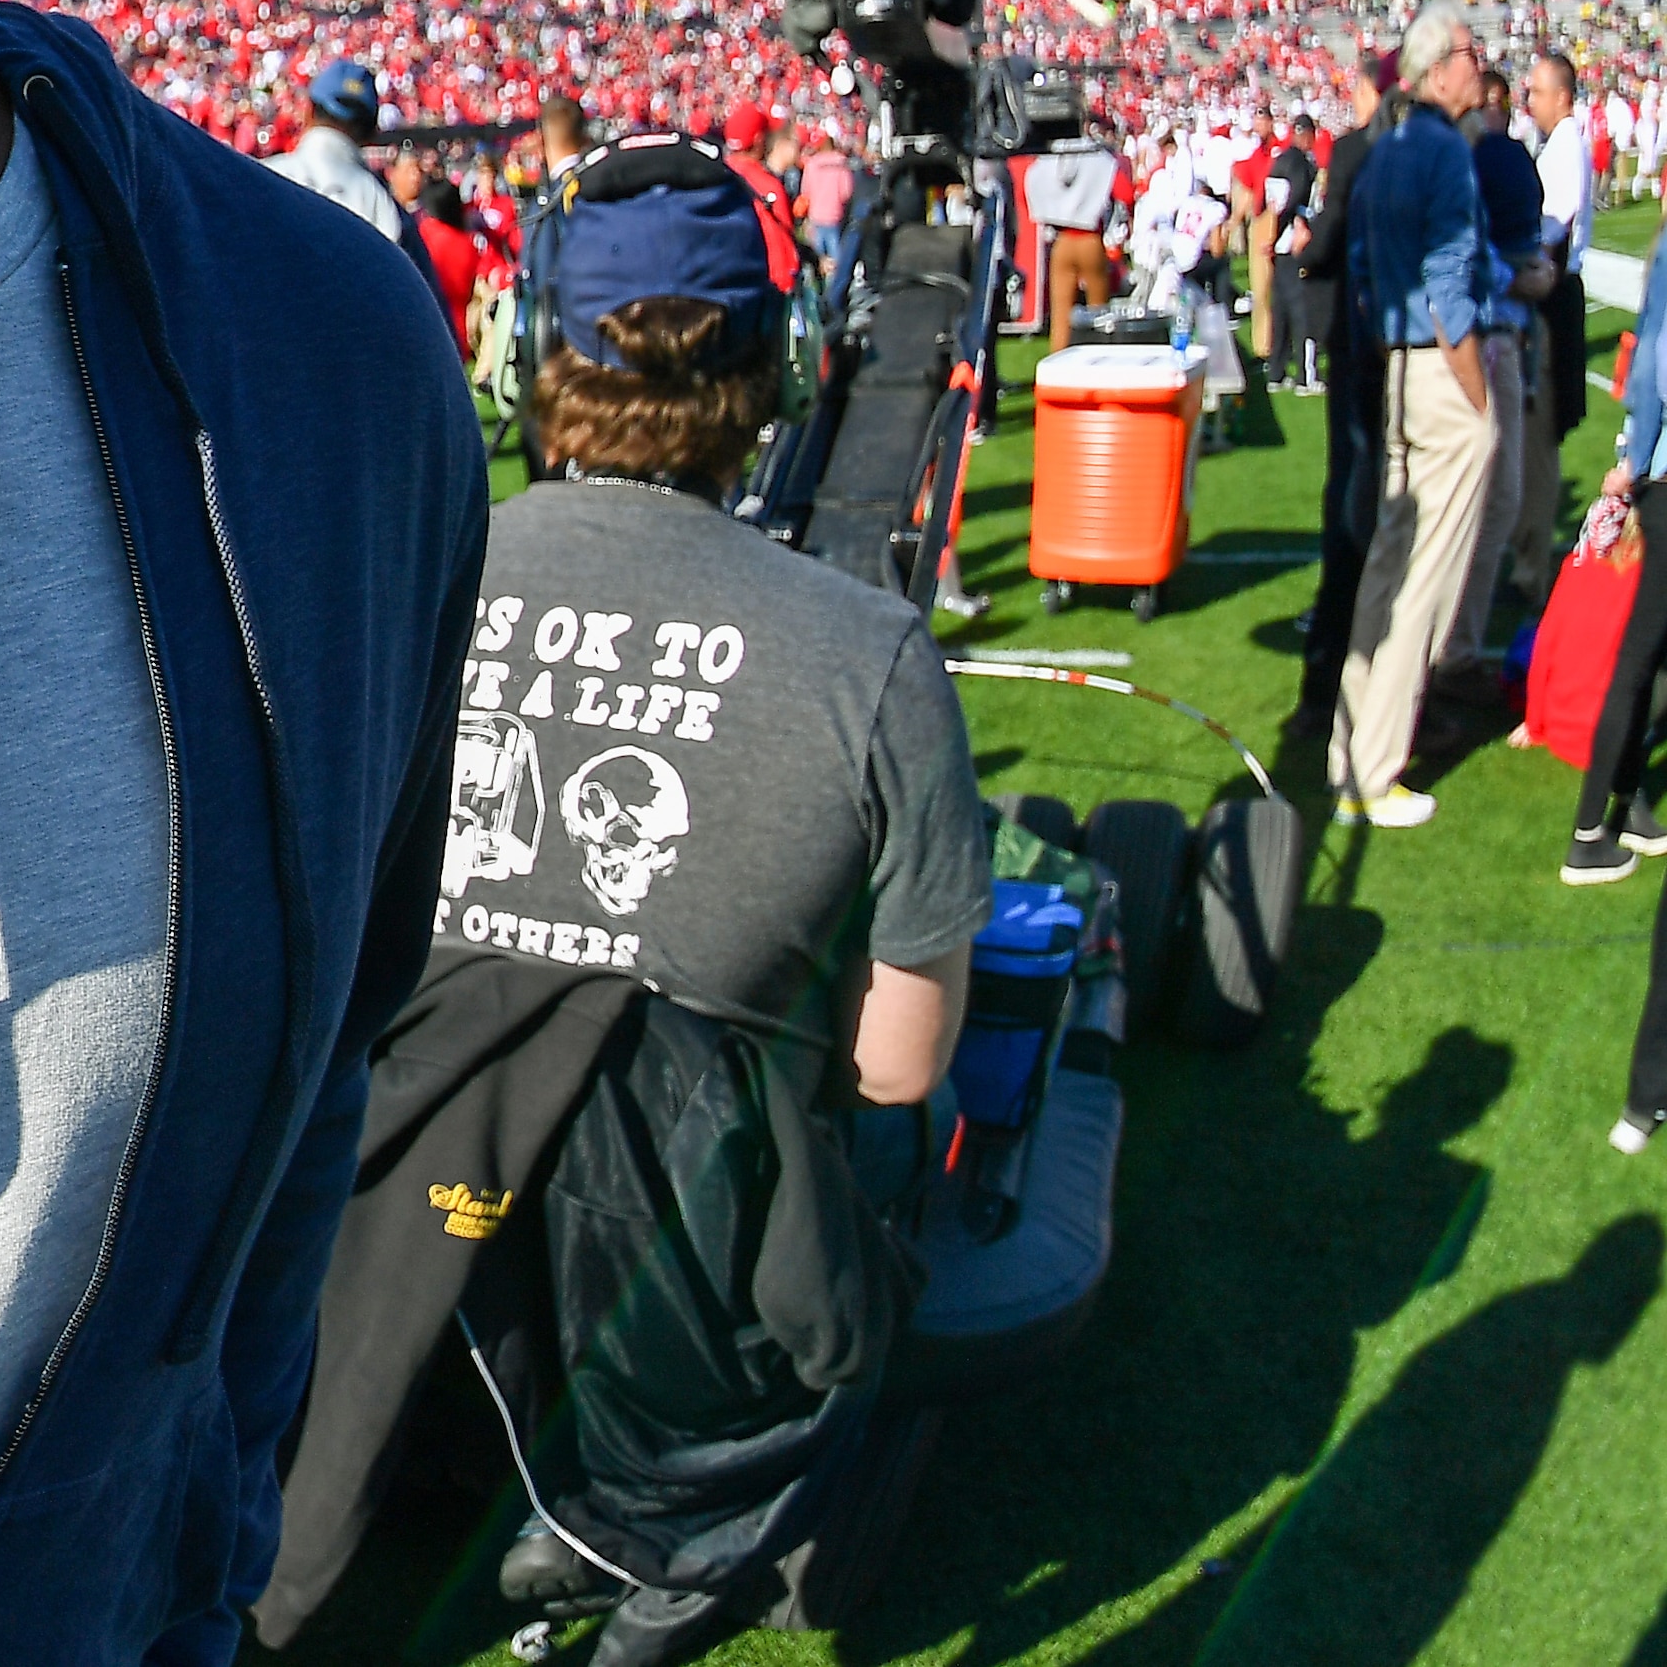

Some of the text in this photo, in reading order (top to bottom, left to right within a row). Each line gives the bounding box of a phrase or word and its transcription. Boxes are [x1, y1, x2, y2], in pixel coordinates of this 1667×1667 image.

[534, 605, 633, 673] OK
[651, 621, 746, 685] TO
[519, 669, 555, 719] A
[572, 677, 722, 743] LIFE
[461, 904, 642, 970] OTHERS
